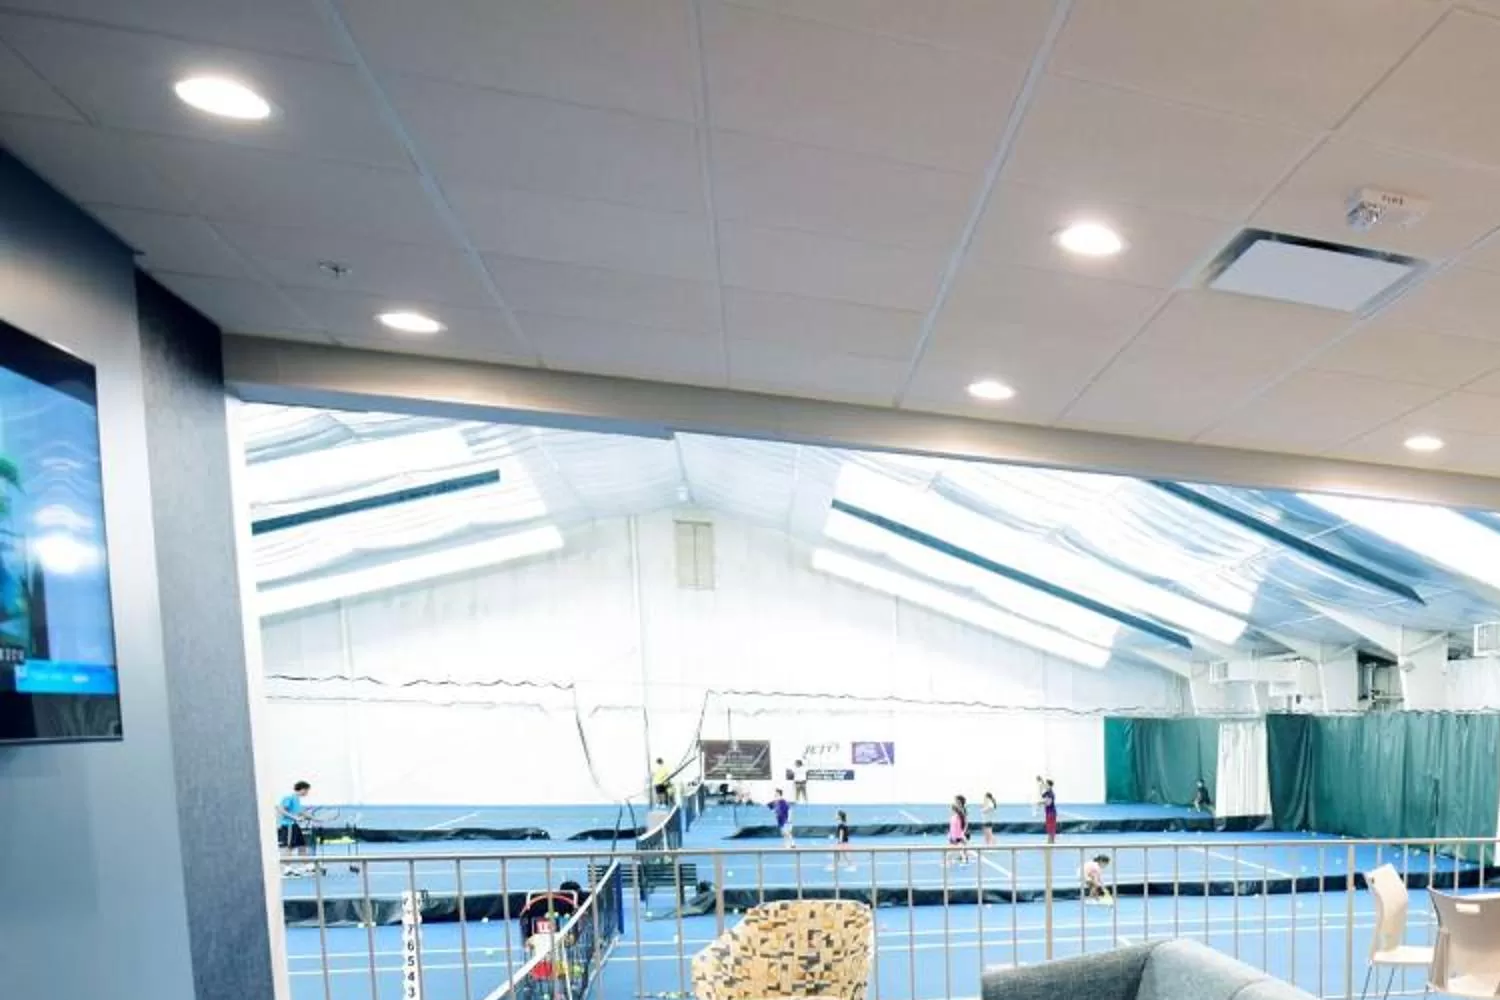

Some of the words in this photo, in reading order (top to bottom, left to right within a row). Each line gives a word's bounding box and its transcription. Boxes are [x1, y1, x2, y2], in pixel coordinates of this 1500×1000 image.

[407, 939, 415, 952] 6
[407, 955, 415, 967] 5
[407, 971, 415, 981] 4
[408, 986, 416, 998] 3
